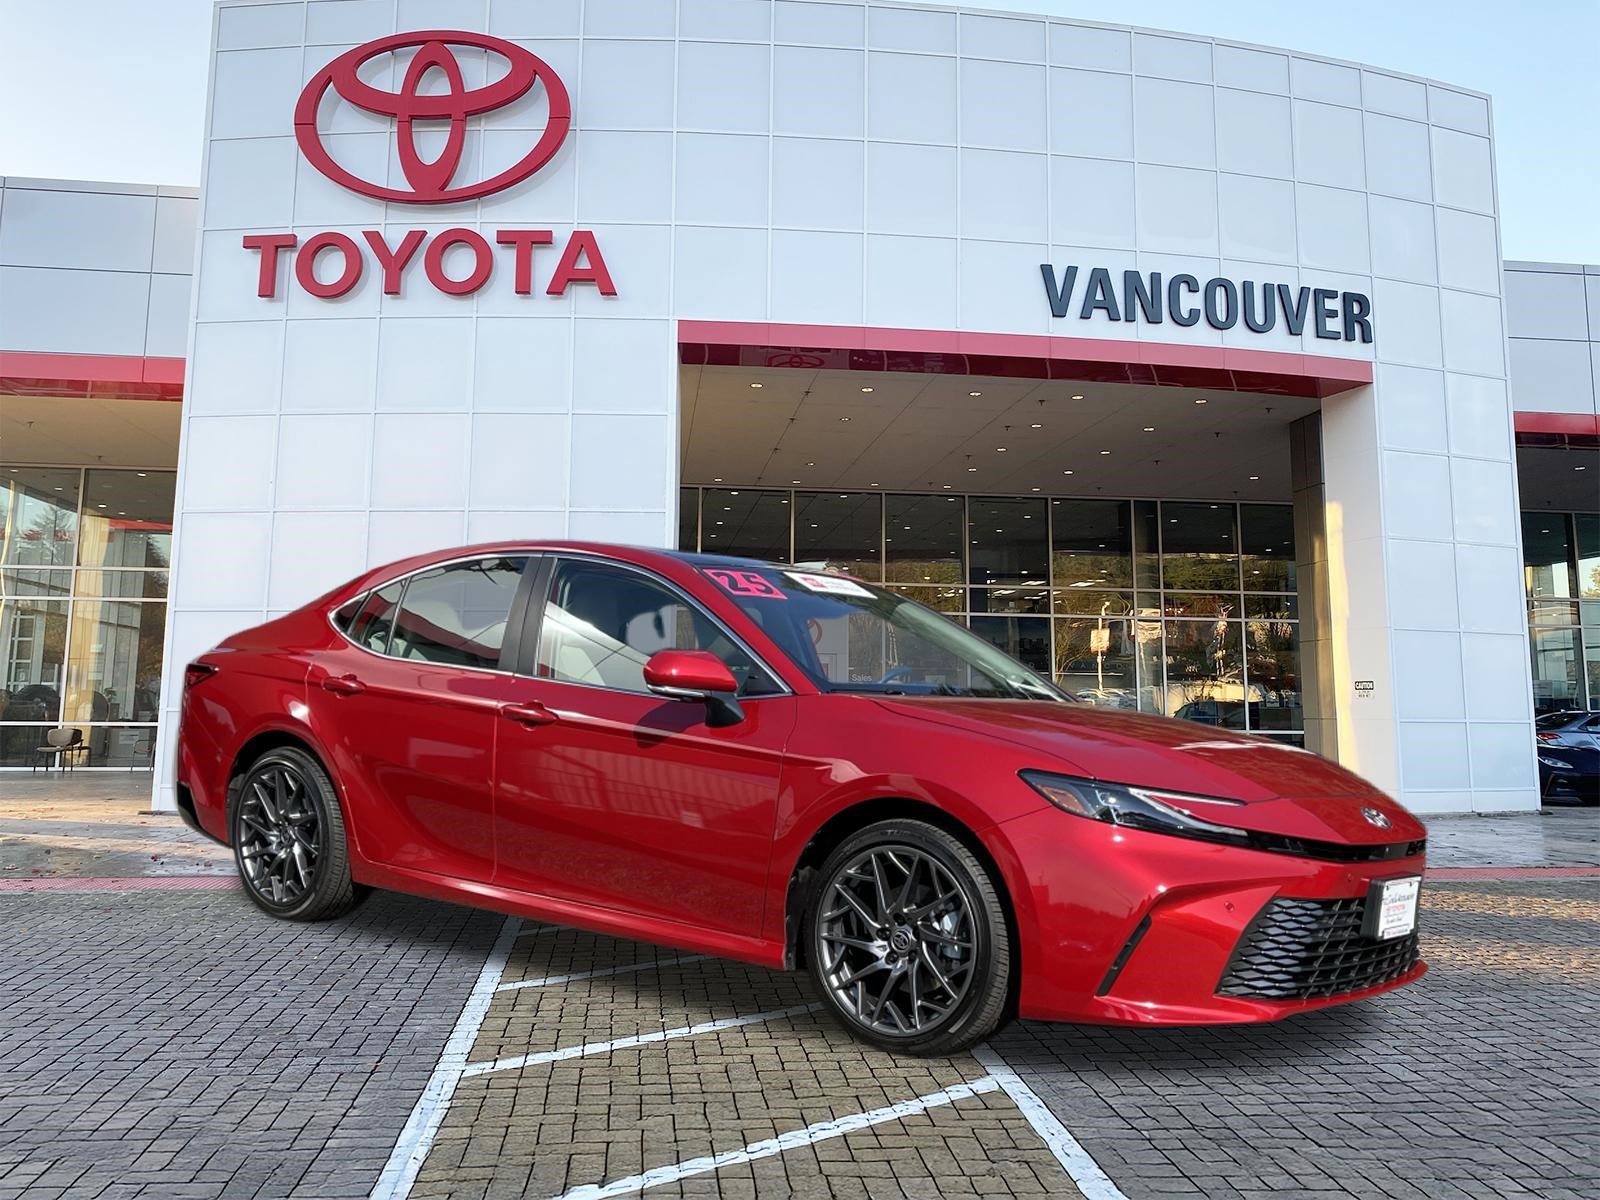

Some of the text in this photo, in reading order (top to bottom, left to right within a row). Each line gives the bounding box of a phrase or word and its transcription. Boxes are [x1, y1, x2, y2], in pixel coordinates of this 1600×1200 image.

[243, 228, 617, 298] TOYOTA
[1040, 264, 1373, 344] VANCOUVER
[712, 572, 774, 594] 25
[851, 673, 873, 682] Sales
